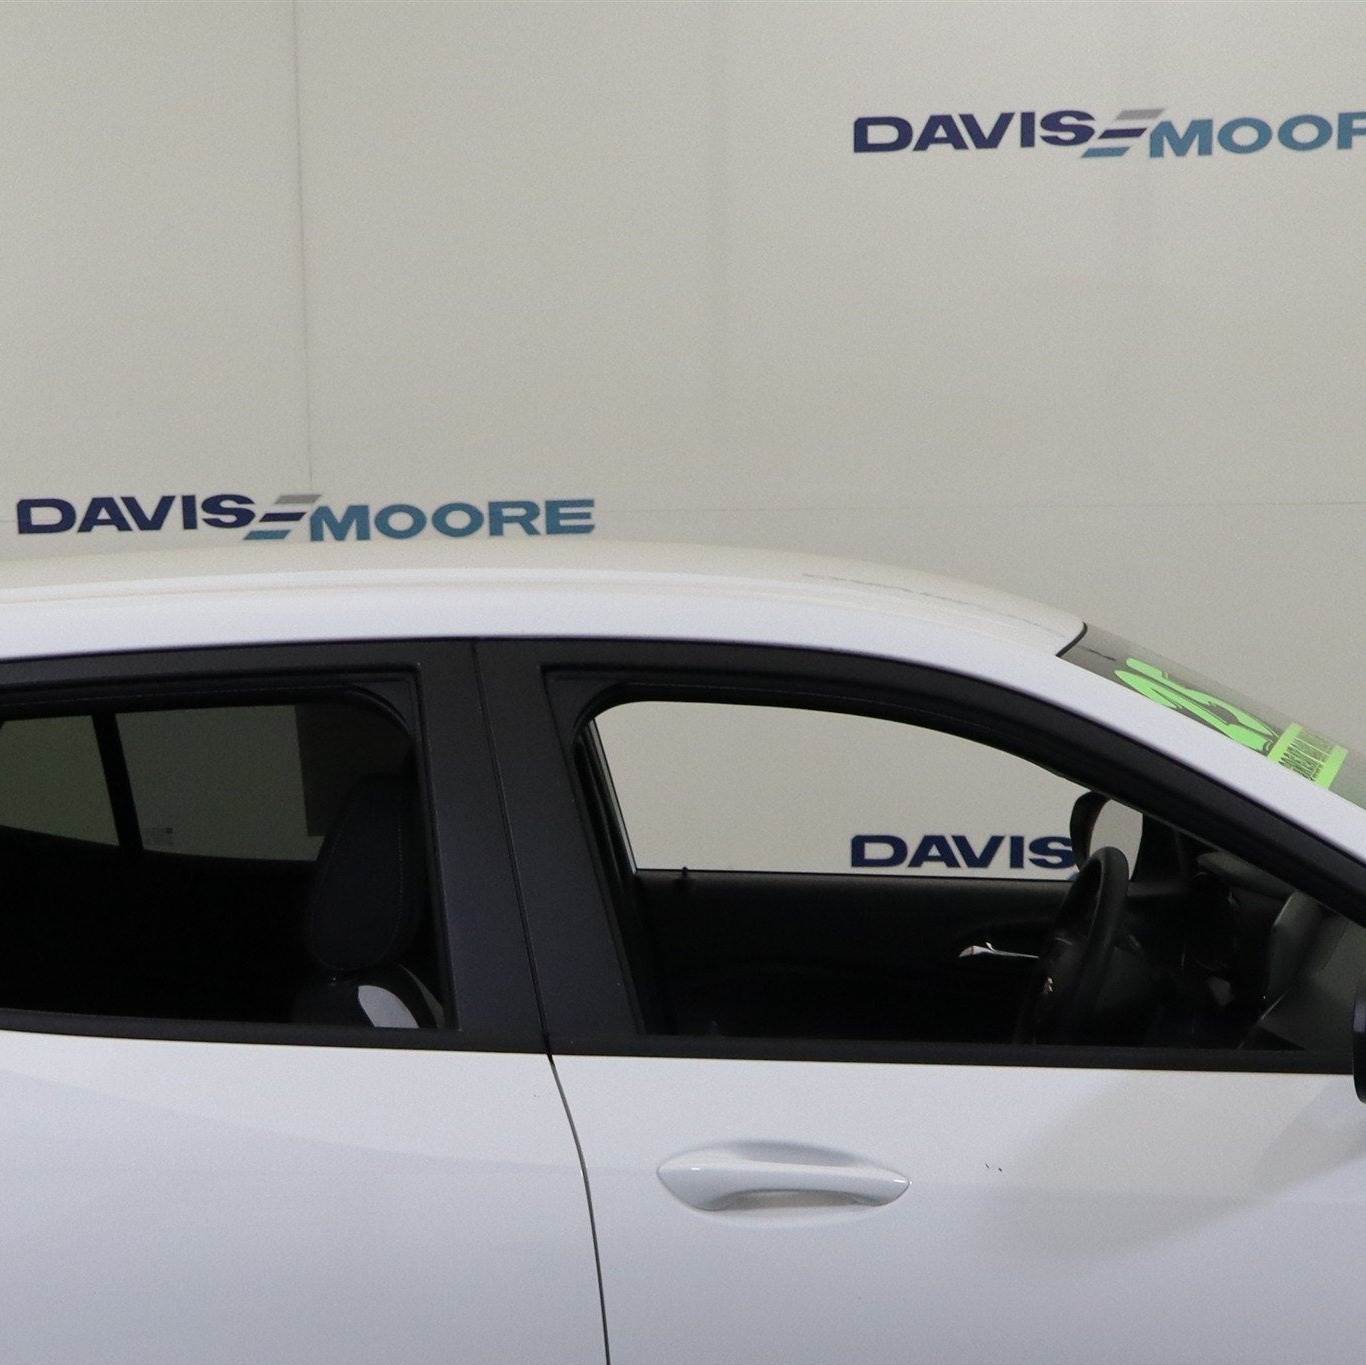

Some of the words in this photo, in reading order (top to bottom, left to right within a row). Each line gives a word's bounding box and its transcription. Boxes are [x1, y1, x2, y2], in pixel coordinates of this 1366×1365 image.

[853, 110, 1096, 154] DAVIS
[16, 493, 256, 535] DAVIS
[309, 499, 595, 541] MOORE
[851, 834, 1075, 870] DAVIS
